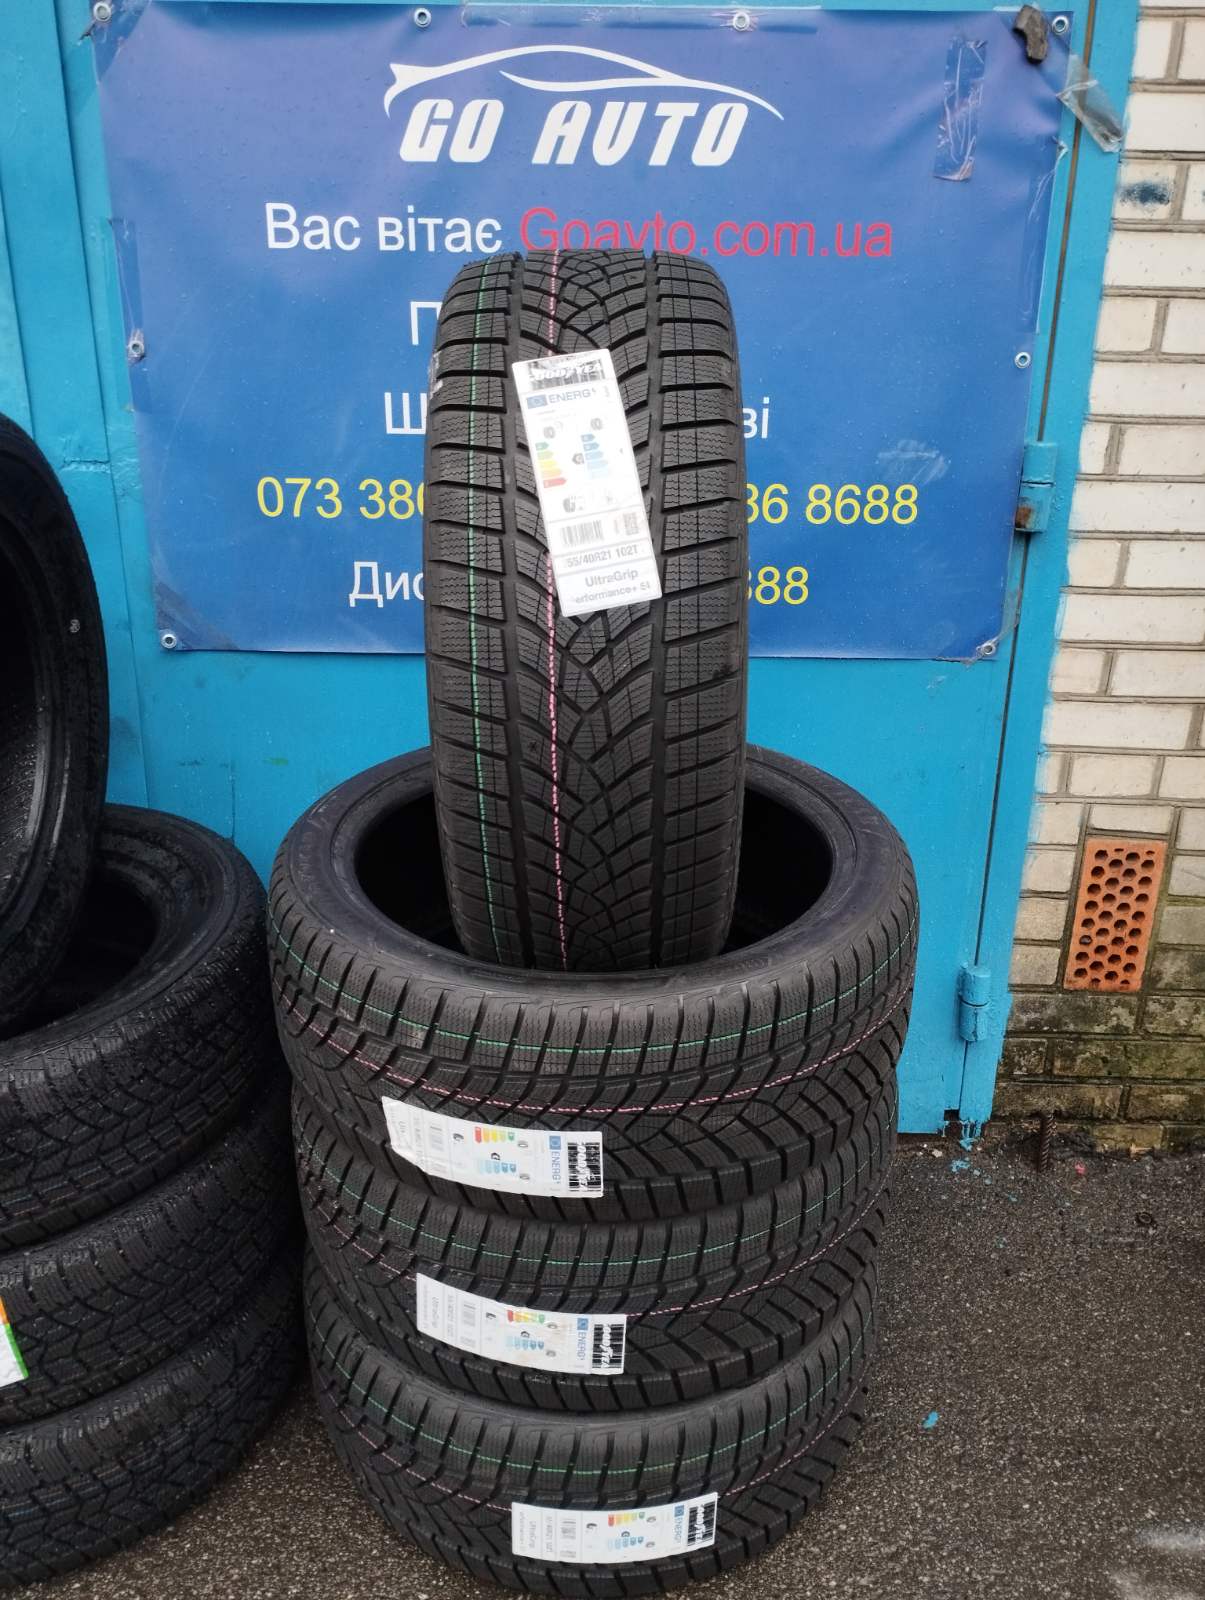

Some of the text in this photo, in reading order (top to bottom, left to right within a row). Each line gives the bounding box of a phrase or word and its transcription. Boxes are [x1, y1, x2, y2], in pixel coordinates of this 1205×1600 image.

[399, 98, 749, 166] GO AUTO
[265, 202, 893, 257] Вас вітає Goavto.com.ua
[257, 476, 343, 519] 073
[805, 483, 918, 525] 8688
[748, 566, 809, 605] 88
